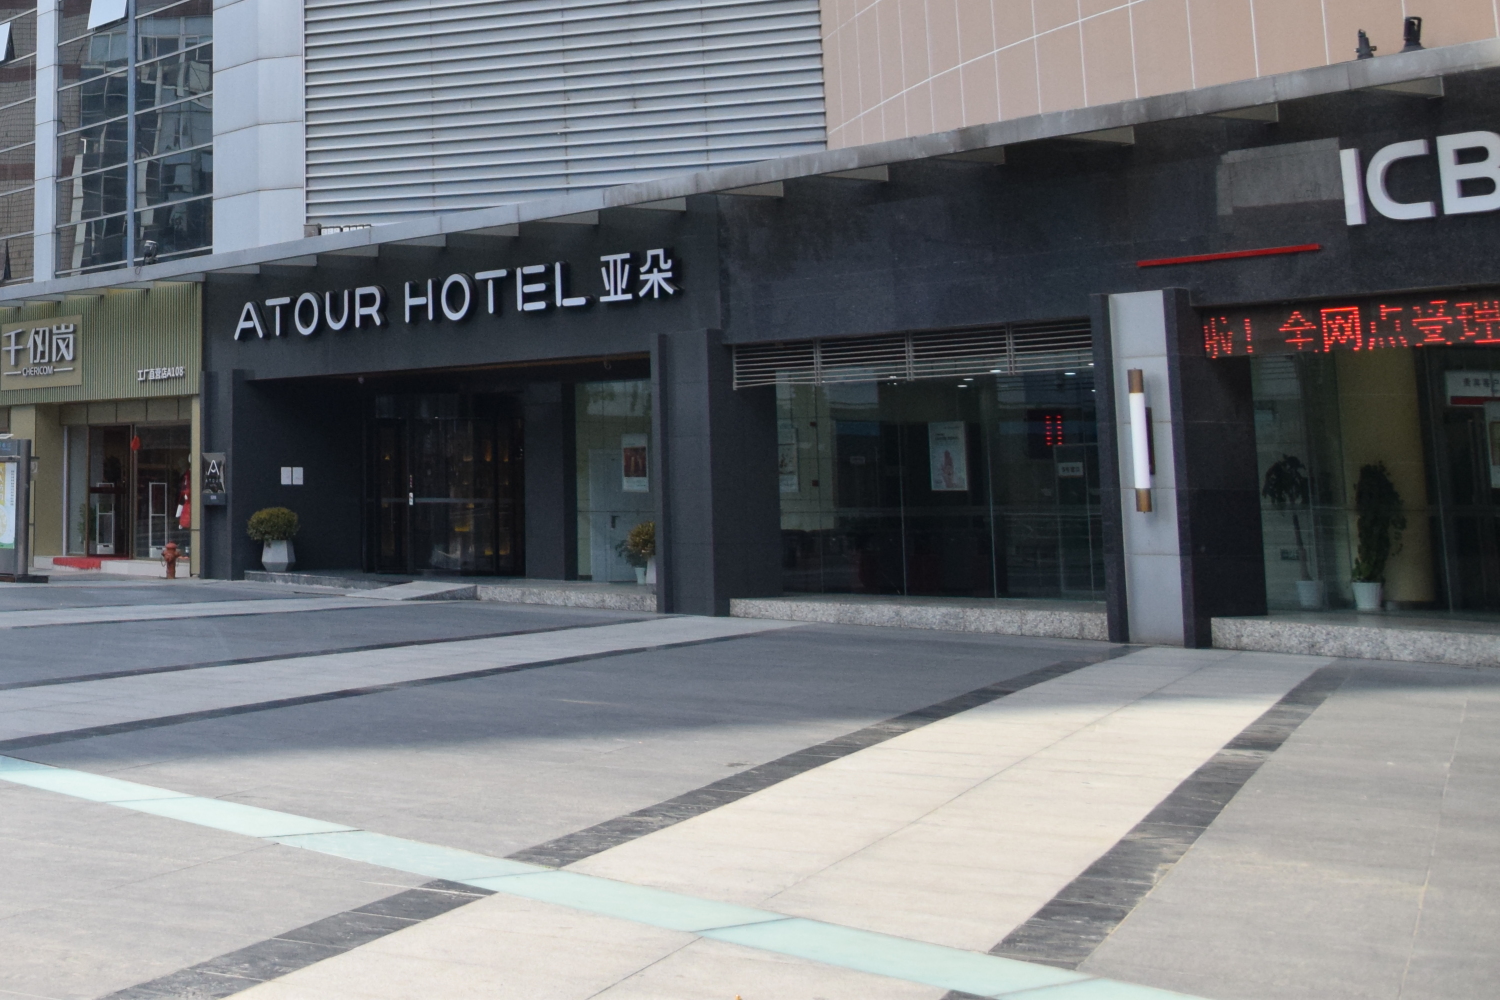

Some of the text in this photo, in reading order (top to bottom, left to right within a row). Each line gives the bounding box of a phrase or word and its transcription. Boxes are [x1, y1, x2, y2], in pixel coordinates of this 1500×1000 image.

[233, 247, 676, 342] ATOUR HOTEL 亚朵
[1, 323, 75, 366] 千仞岗
[22, 365, 54, 377] CHERICOM
